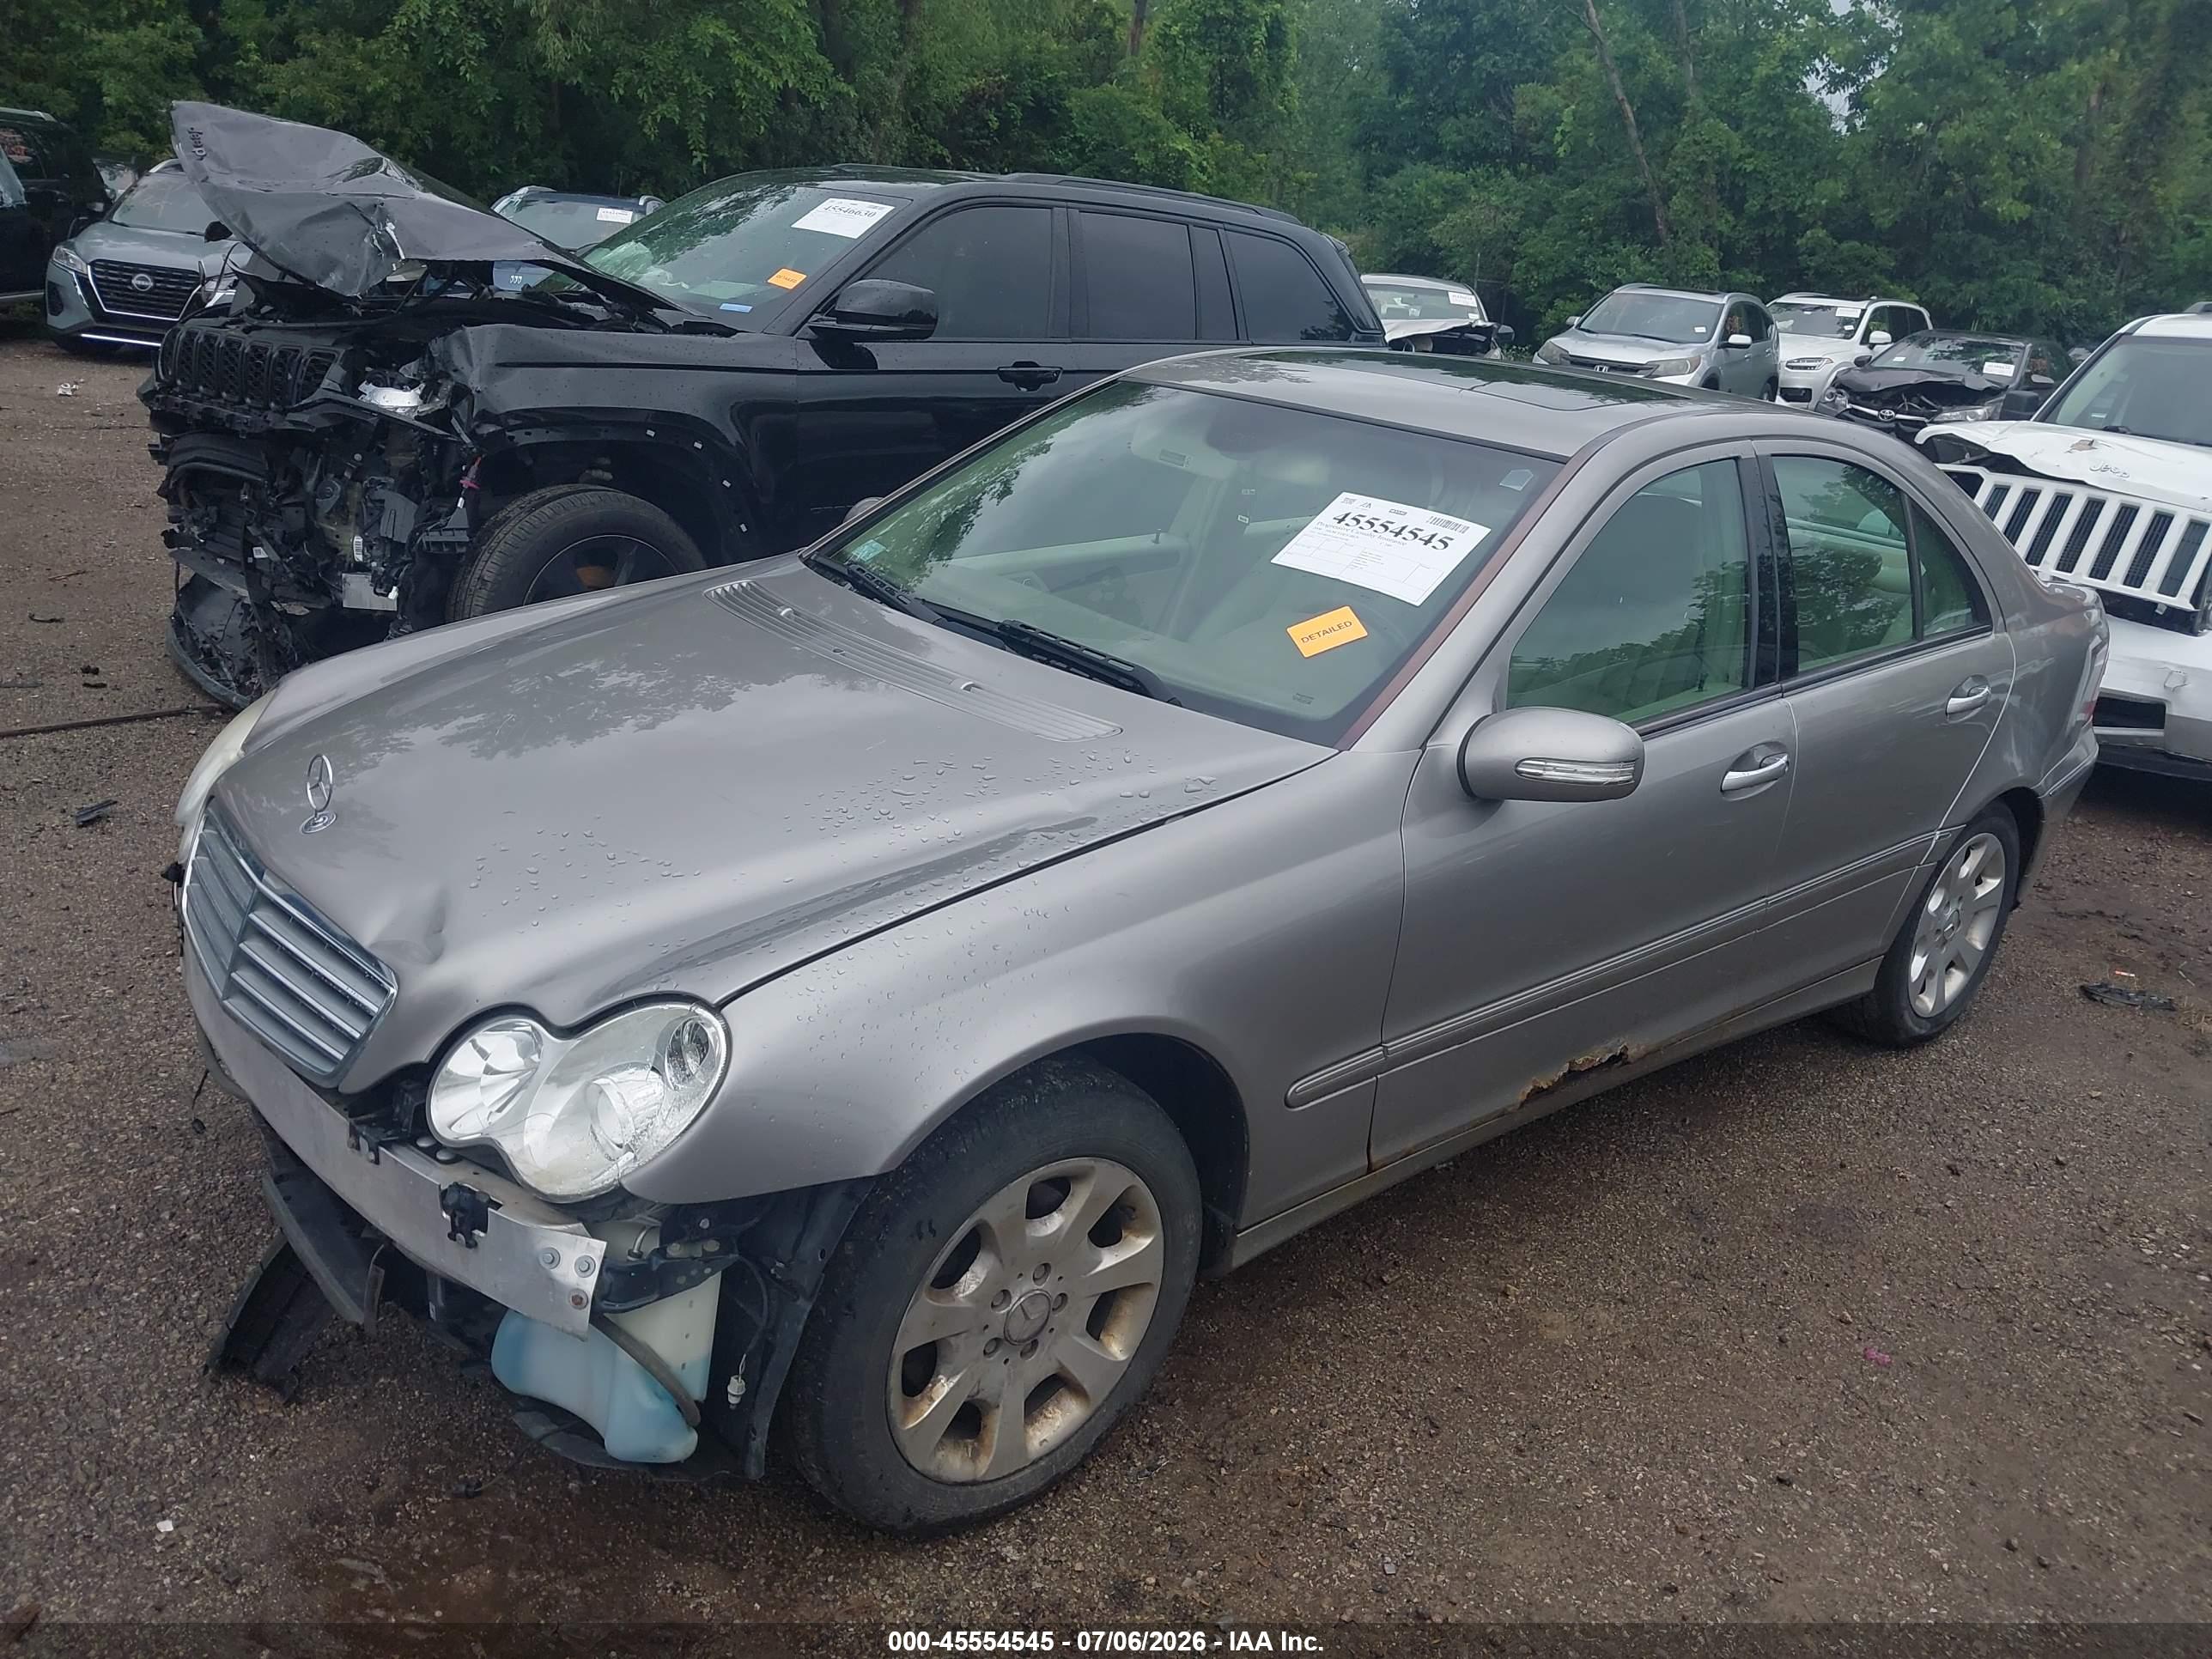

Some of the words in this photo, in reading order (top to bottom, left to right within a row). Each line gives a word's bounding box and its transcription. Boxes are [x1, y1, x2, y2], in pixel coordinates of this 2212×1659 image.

[187, 127, 207, 161] Jeep
[2088, 461, 2130, 481] Jeep
[1333, 512, 1454, 550] 45554545
[1300, 621, 1352, 643] DETAILED
